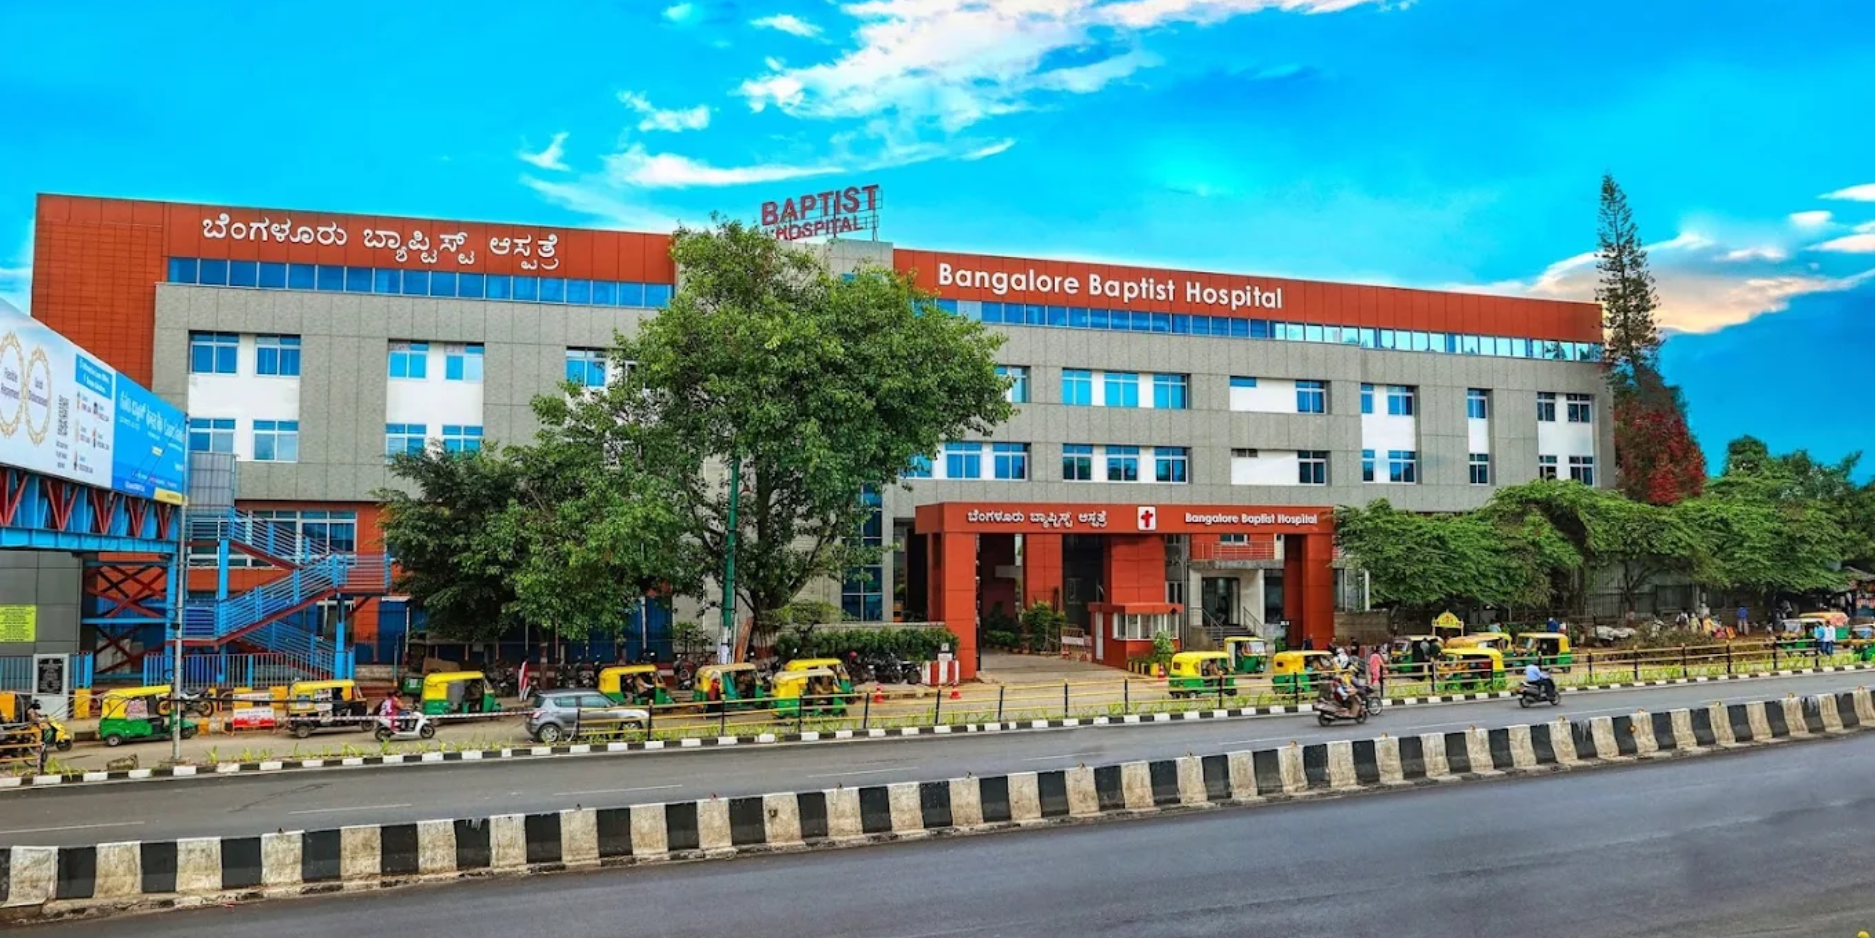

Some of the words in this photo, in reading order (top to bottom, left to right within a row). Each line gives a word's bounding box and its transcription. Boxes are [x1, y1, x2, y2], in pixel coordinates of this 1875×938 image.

[761, 184, 879, 225] BAPTIST
[202, 212, 348, 246] ಬೆಂಗಳೂರು
[363, 228, 475, 265] ಬ್ಯಾಪ್ಟಿಸ್ಟ್
[489, 233, 559, 270] ಆಸ್ಪತ್ರೆ
[775, 215, 863, 240] HOSPITAL
[938, 262, 1080, 296] Bangalore
[1088, 273, 1176, 303] Baptist
[1185, 281, 1283, 310] Hospital
[968, 509, 1024, 522] ಬೆಂಗಳೂರು
[1185, 512, 1239, 525] Bangalore
[1241, 514, 1276, 525] Baptist
[1277, 514, 1318, 526] Hospital
